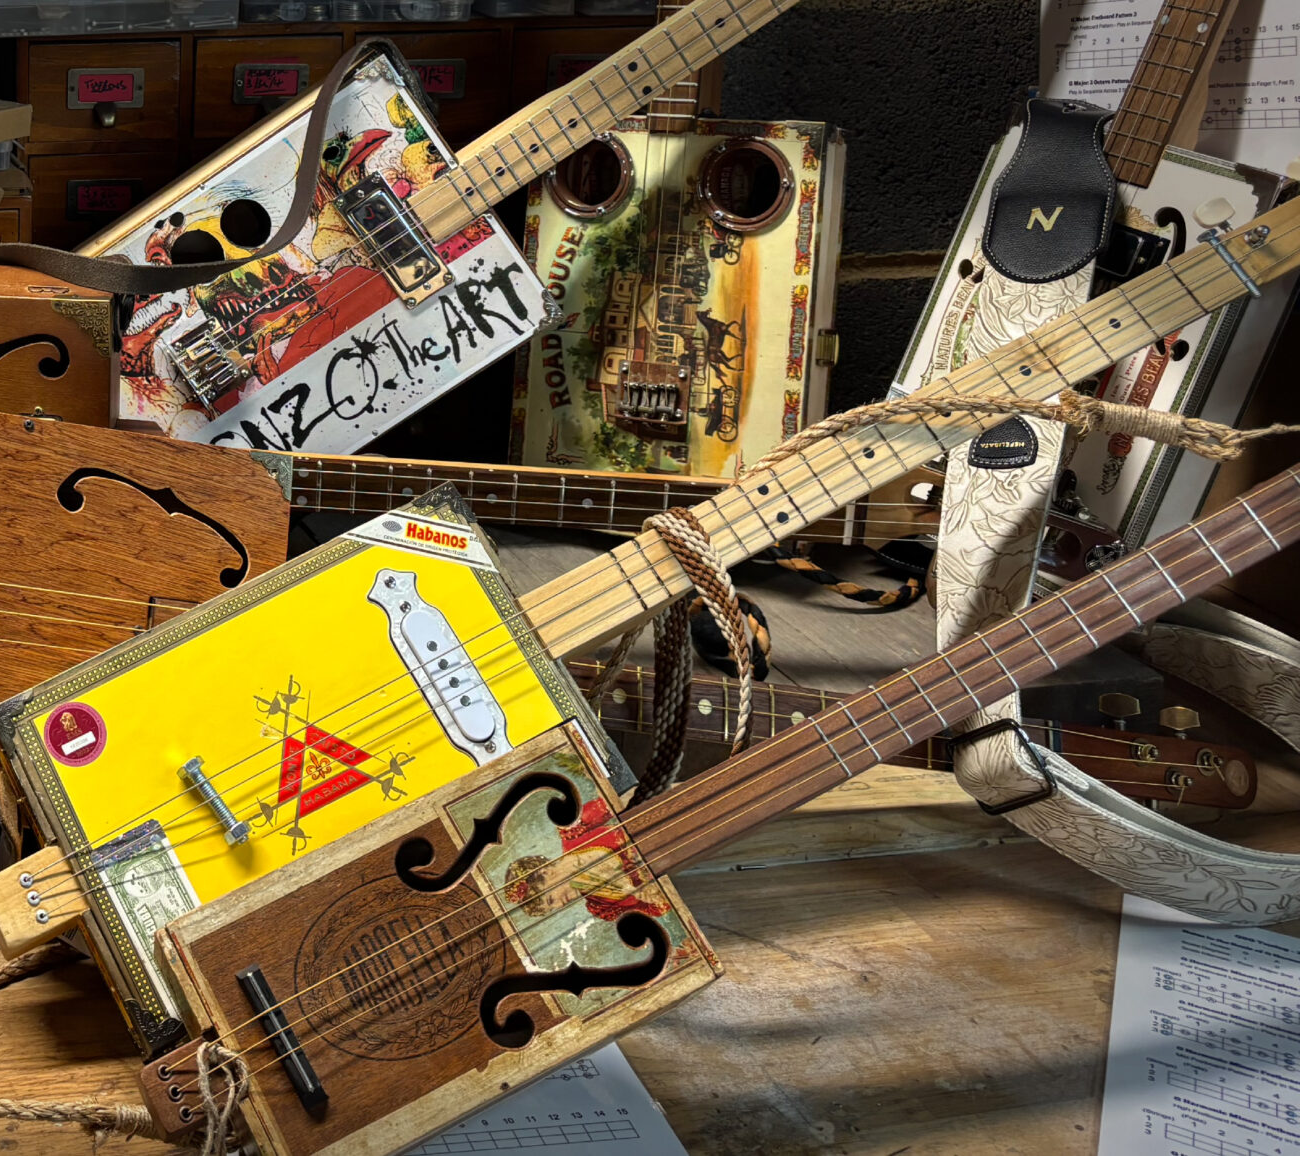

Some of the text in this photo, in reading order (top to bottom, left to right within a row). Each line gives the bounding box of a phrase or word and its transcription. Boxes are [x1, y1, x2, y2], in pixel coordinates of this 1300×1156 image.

[1026, 206, 1064, 232] N
[436, 262, 535, 364] ART
[541, 226, 578, 409] ROAD OUSE
[406, 522, 468, 550] Habanos
[304, 775, 358, 807] HABANA
[336, 914, 465, 1014] MARCELLA
[481, 1119, 489, 1127] 9
[502, 1117, 515, 1125] 10
[525, 1115, 537, 1123] 11
[548, 1113, 560, 1121] 12
[594, 1110, 606, 1118] 14
[616, 1108, 629, 1116] 15
